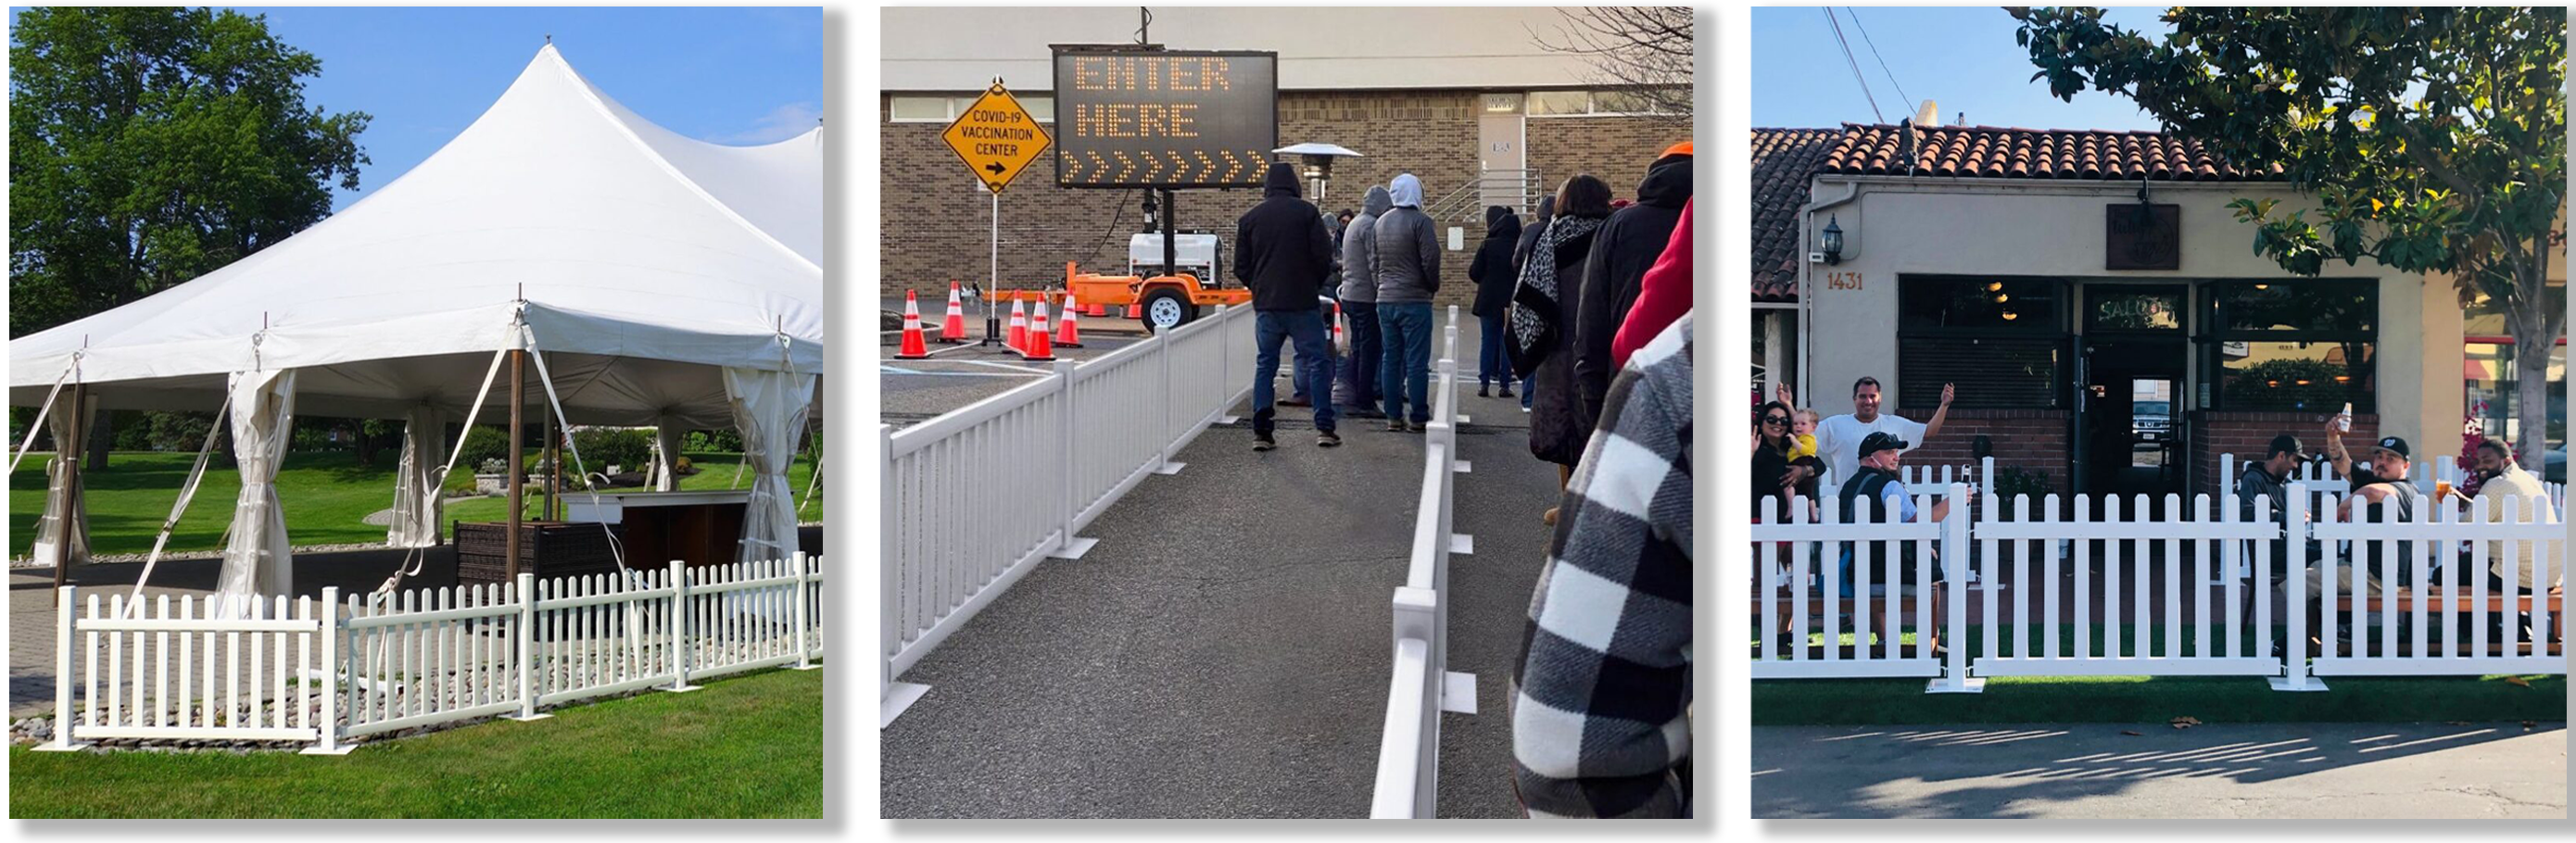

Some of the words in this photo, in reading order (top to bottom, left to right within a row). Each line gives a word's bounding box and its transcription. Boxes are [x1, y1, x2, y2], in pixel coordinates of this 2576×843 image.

[1076, 57, 1230, 91] ENTER
[973, 110, 1022, 123] COVID-19
[1076, 103, 1199, 137] HERE
[961, 126, 1034, 141] VACCINATION
[975, 143, 1018, 157] CENTER
[1826, 271, 1863, 290] 1431
